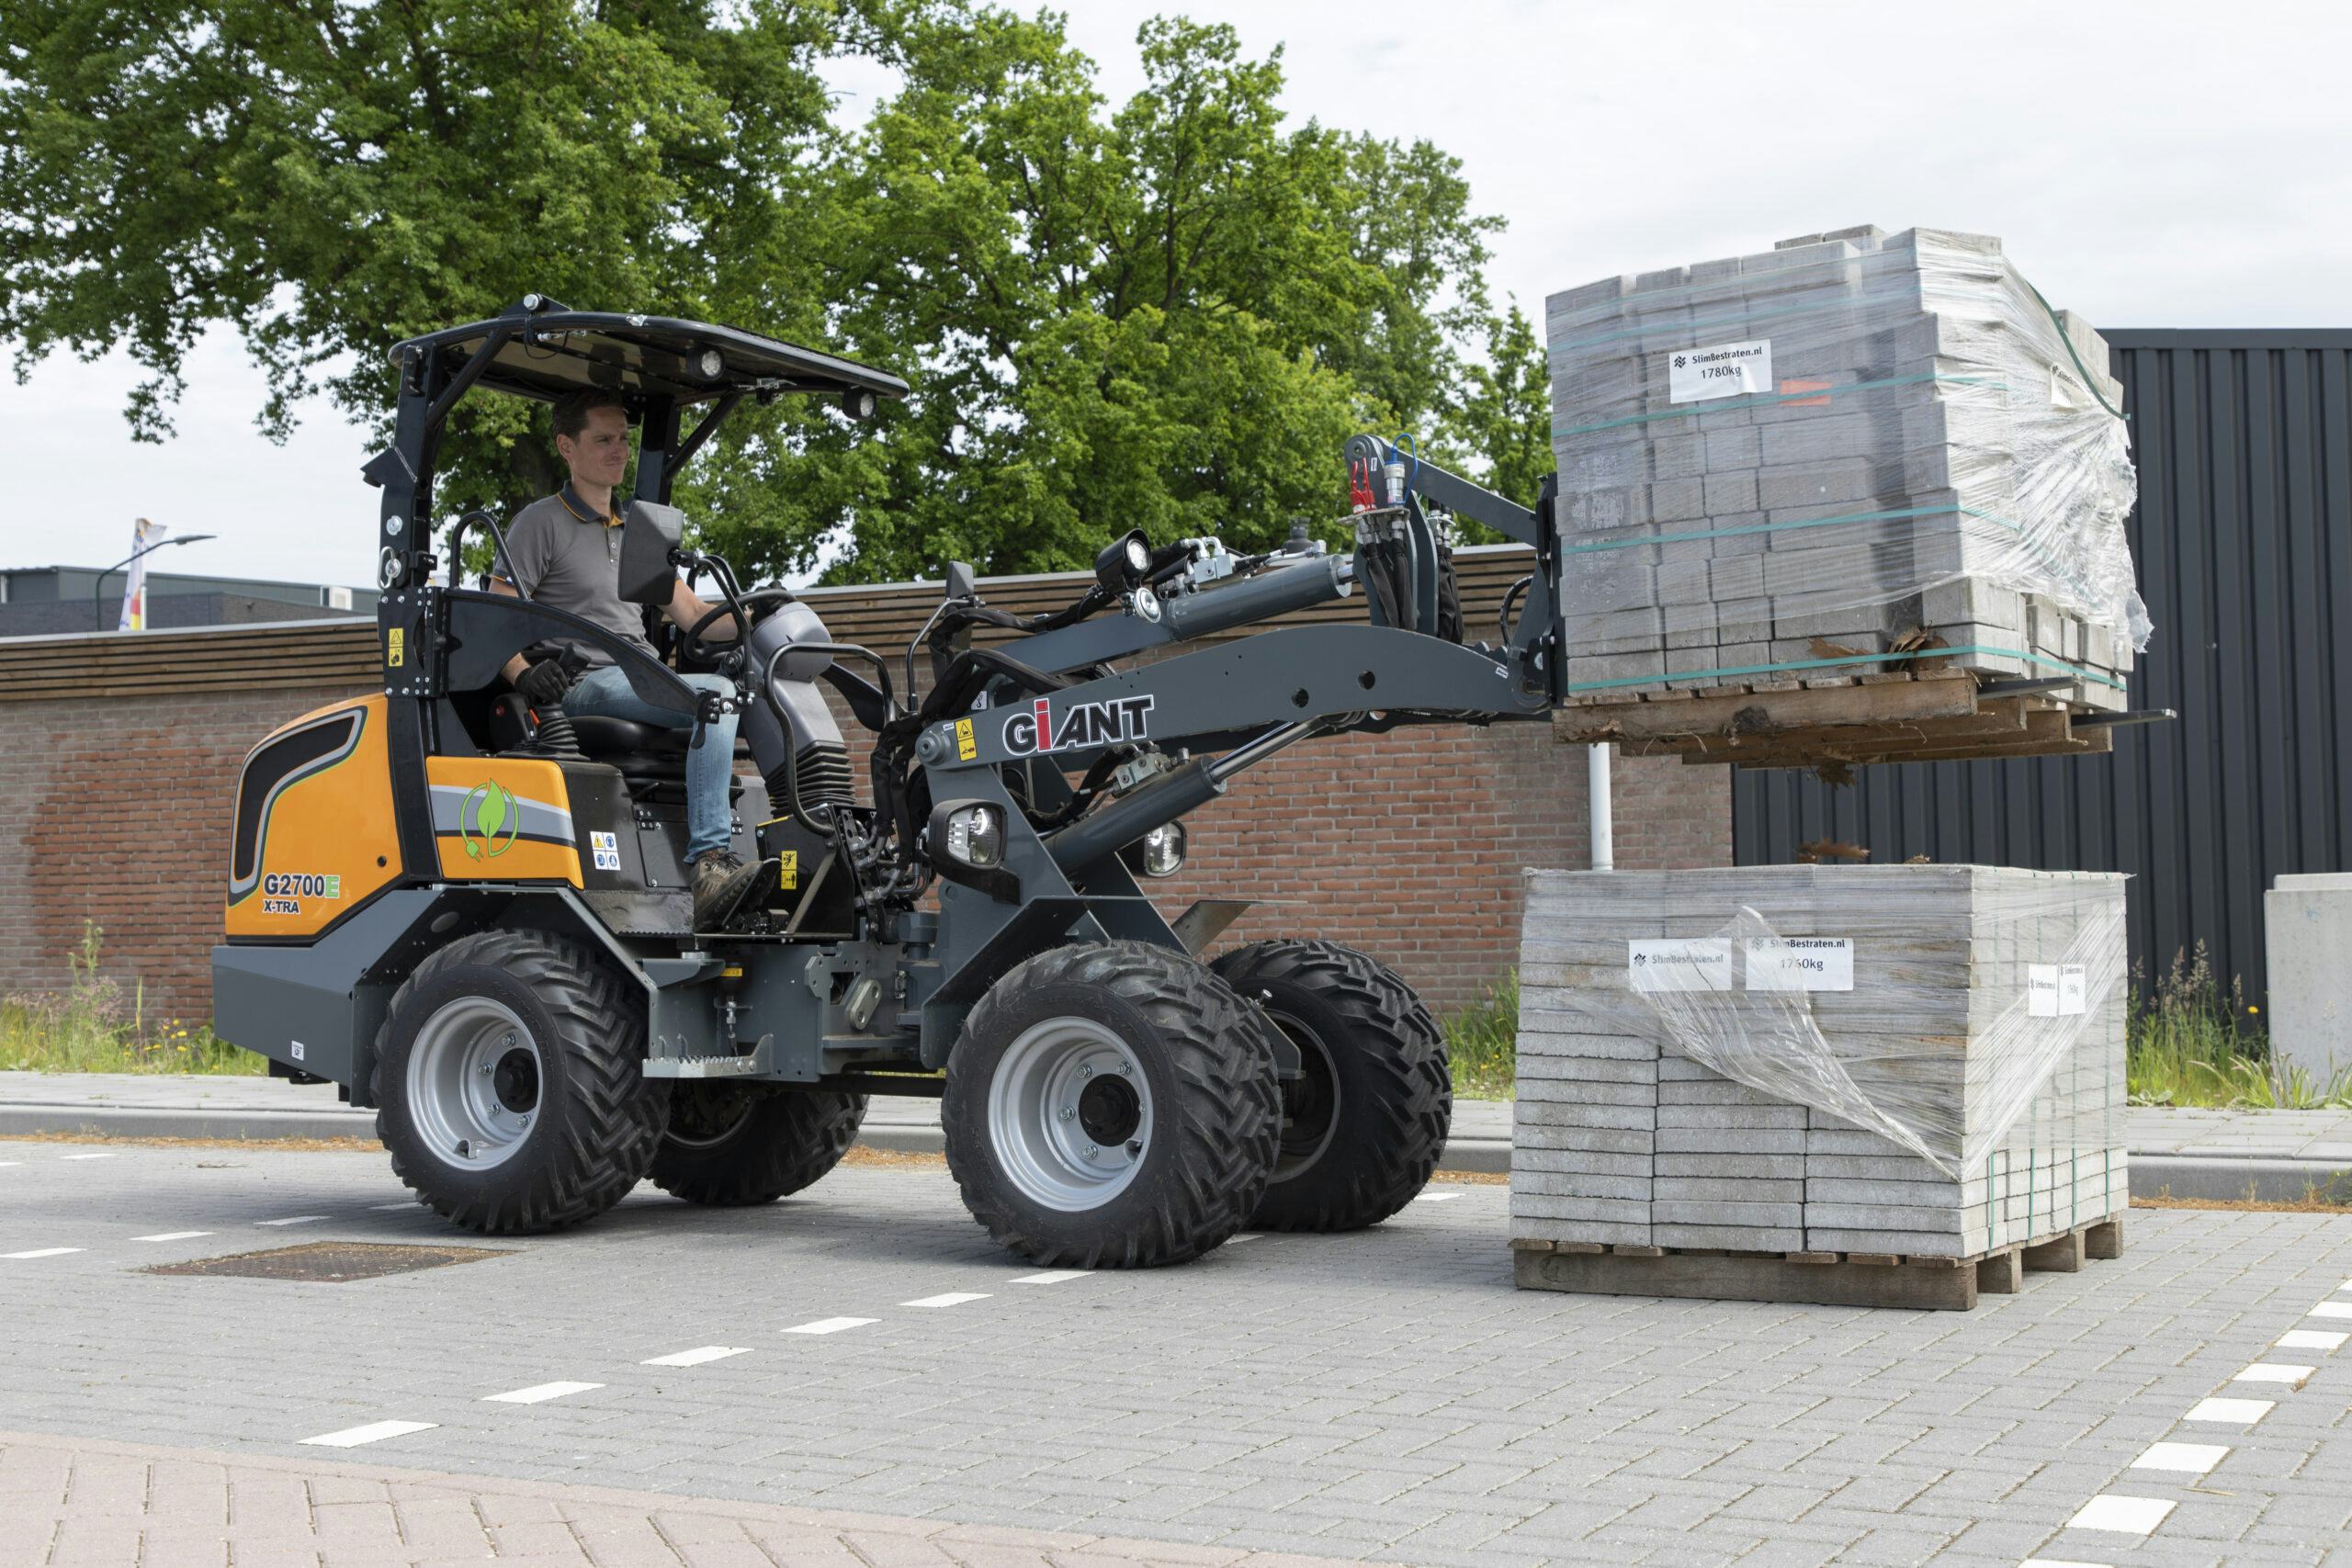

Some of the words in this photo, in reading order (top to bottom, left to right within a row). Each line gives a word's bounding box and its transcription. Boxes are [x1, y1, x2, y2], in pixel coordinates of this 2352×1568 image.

[1692, 346, 1762, 364] SlimBestraten.nl
[1701, 366, 1742, 379] 1780kg
[264, 873, 340, 898] G2700E
[263, 899, 300, 914] X-TRA
